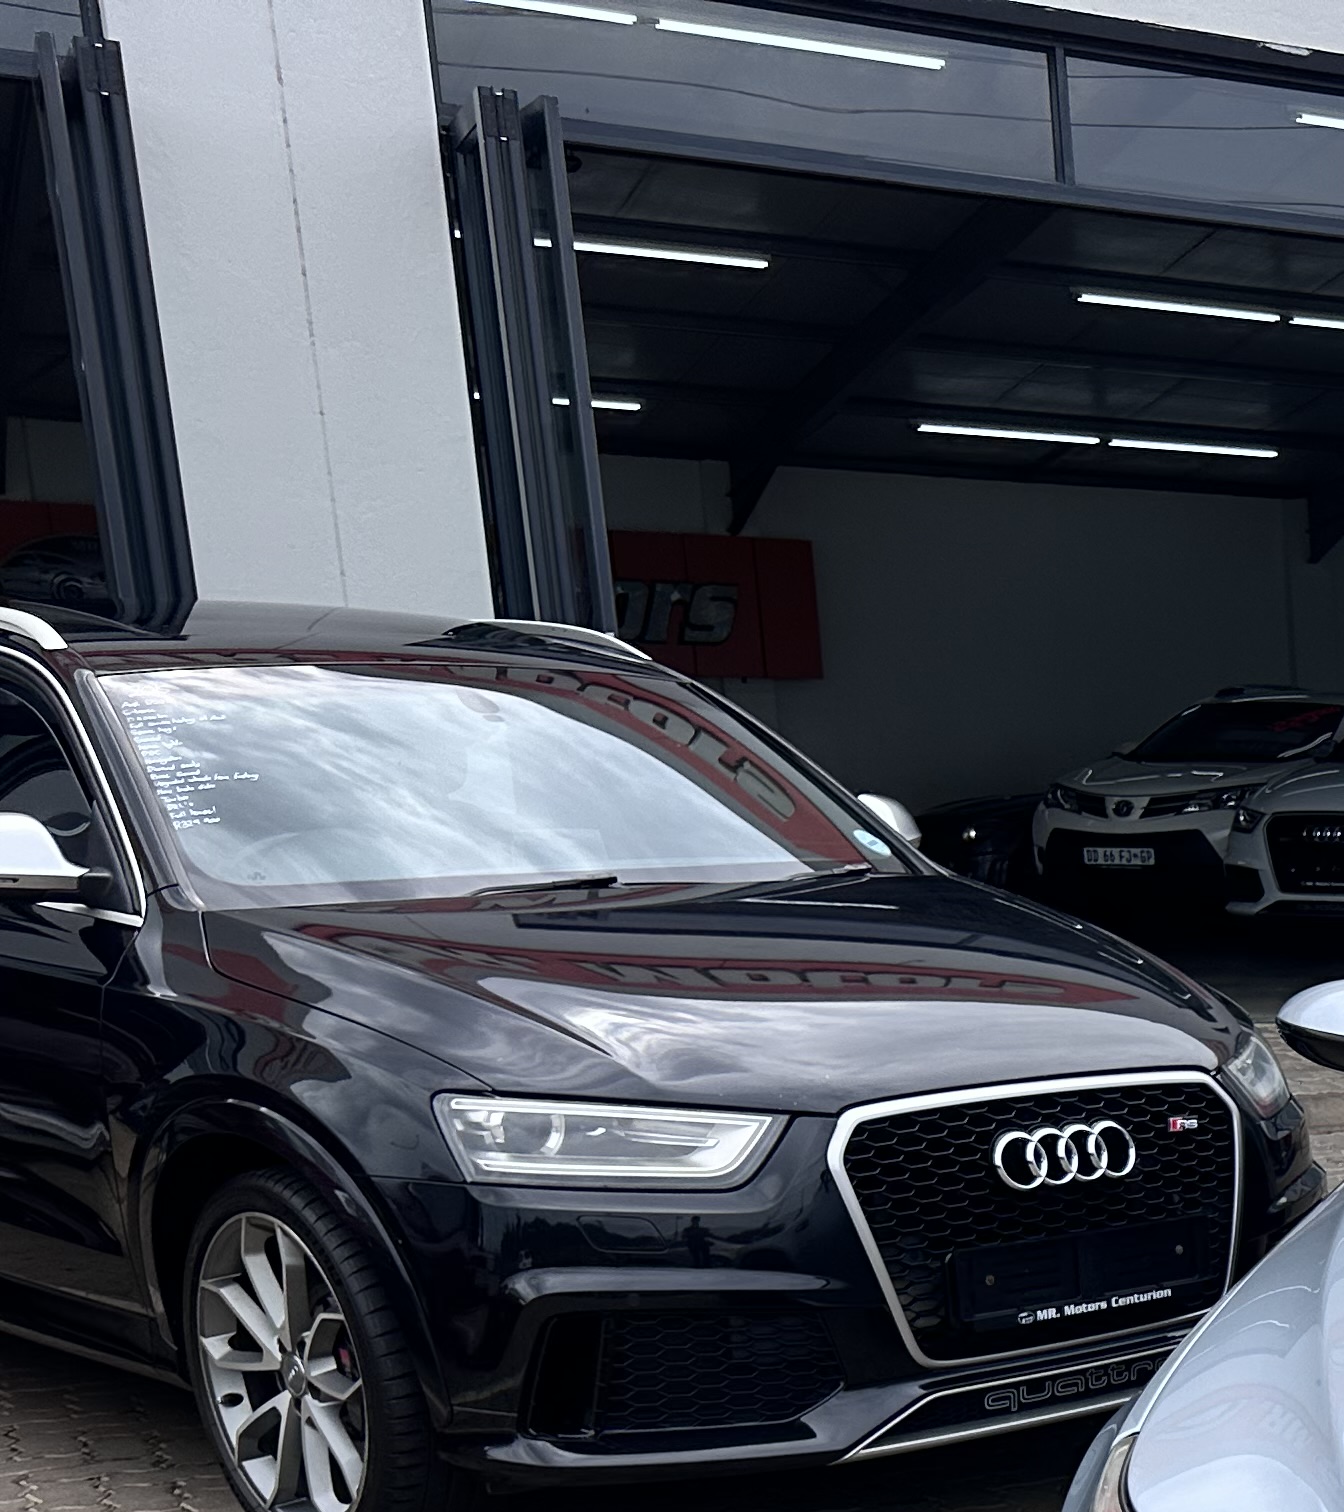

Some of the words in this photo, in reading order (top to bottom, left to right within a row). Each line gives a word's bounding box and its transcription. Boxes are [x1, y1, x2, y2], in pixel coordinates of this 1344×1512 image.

[1140, 849, 1153, 864] GP
[1036, 1307, 1061, 1322] MR.
[1064, 1300, 1107, 1317] Motors
[1111, 1287, 1172, 1308] Centurion
